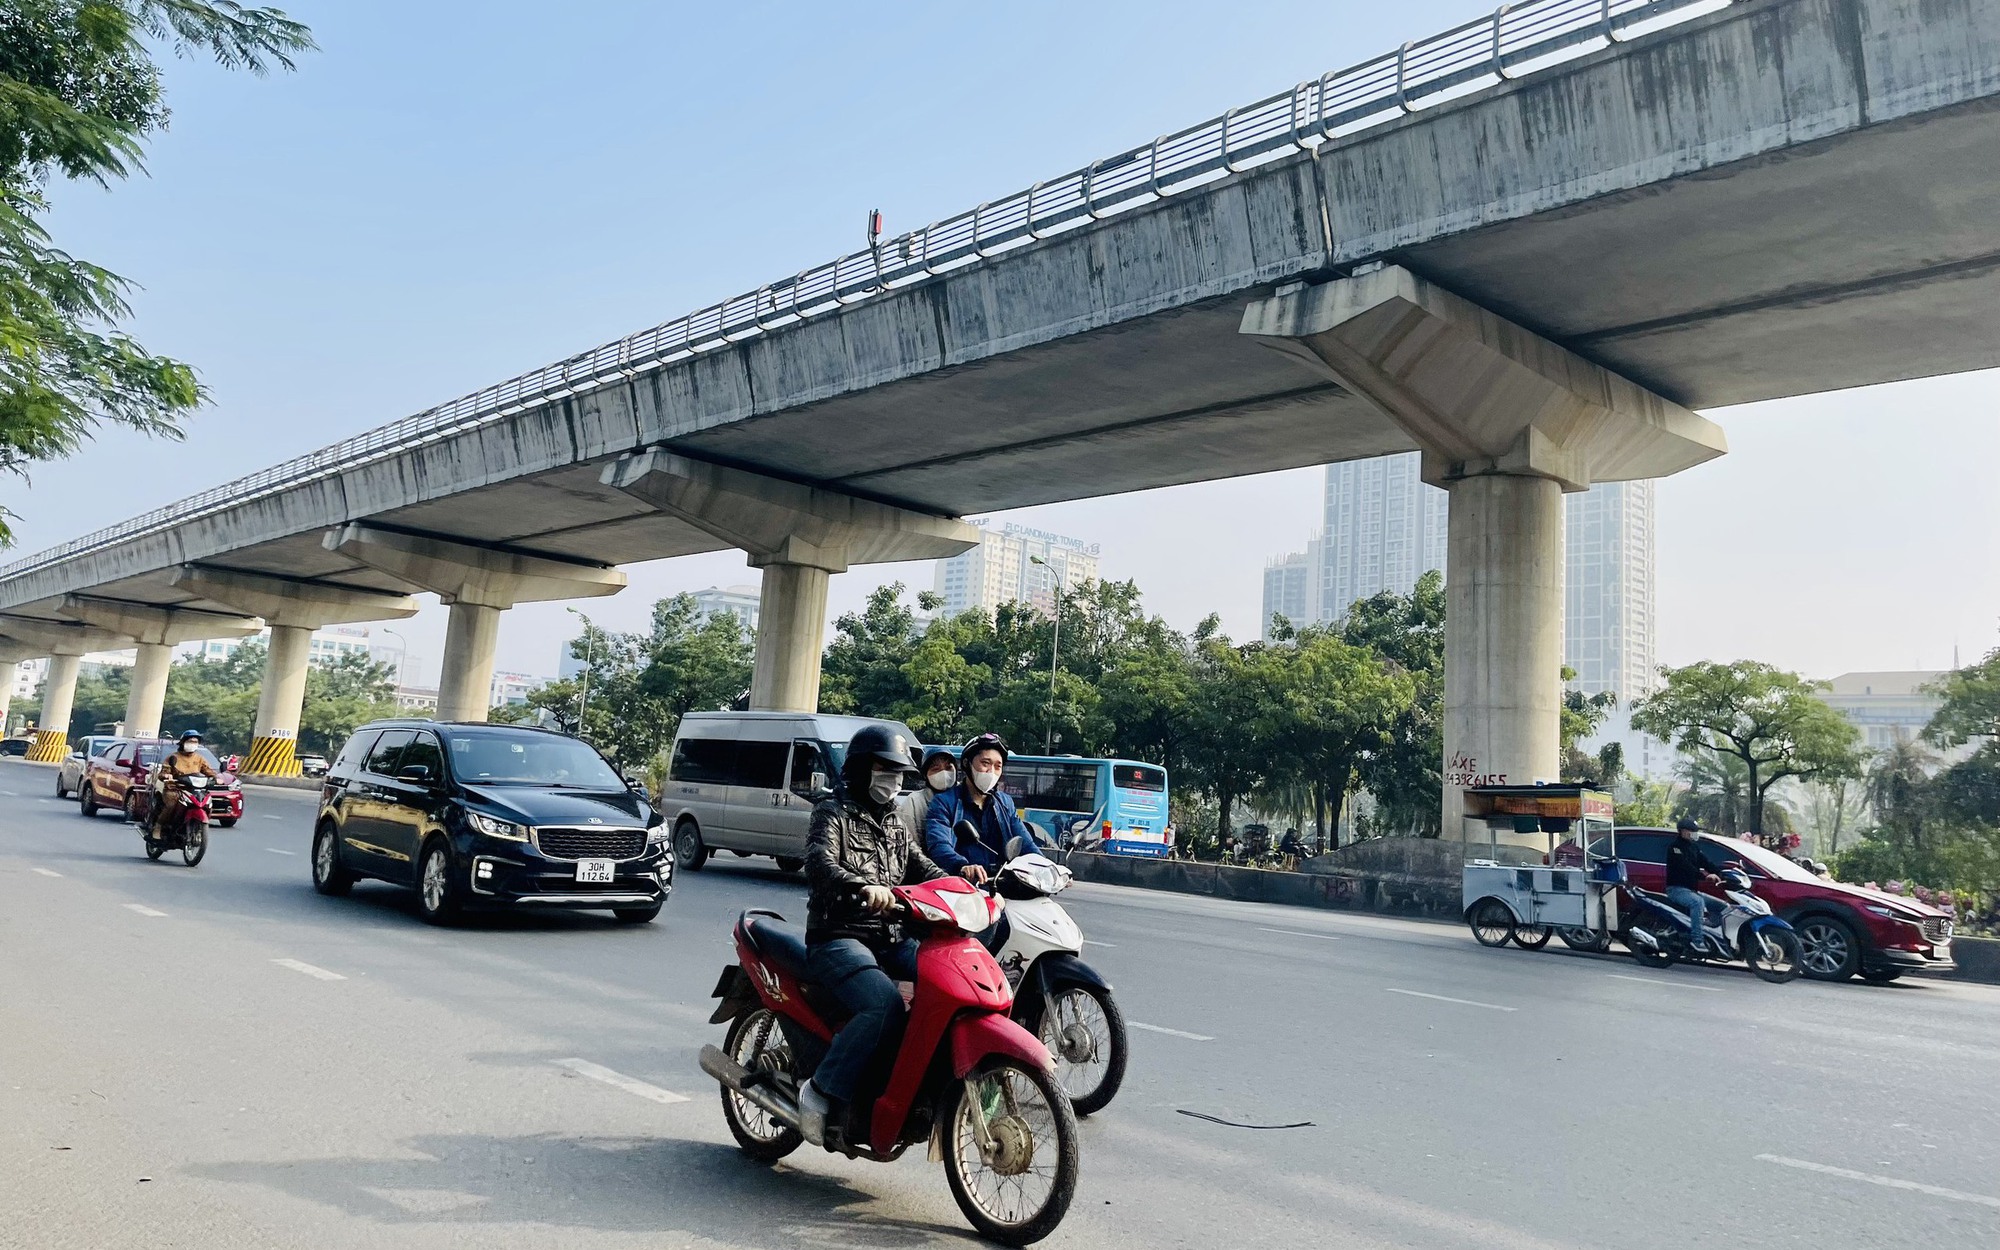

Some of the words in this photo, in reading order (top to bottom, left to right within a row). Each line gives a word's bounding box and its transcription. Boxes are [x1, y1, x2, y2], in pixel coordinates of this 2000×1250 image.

[1005, 521, 1020, 533] FLC
[1020, 525, 1058, 544] LANDMARK
[1060, 534, 1084, 550] TOWER
[588, 862, 605, 872] 30H
[581, 871, 610, 881] 112.64
